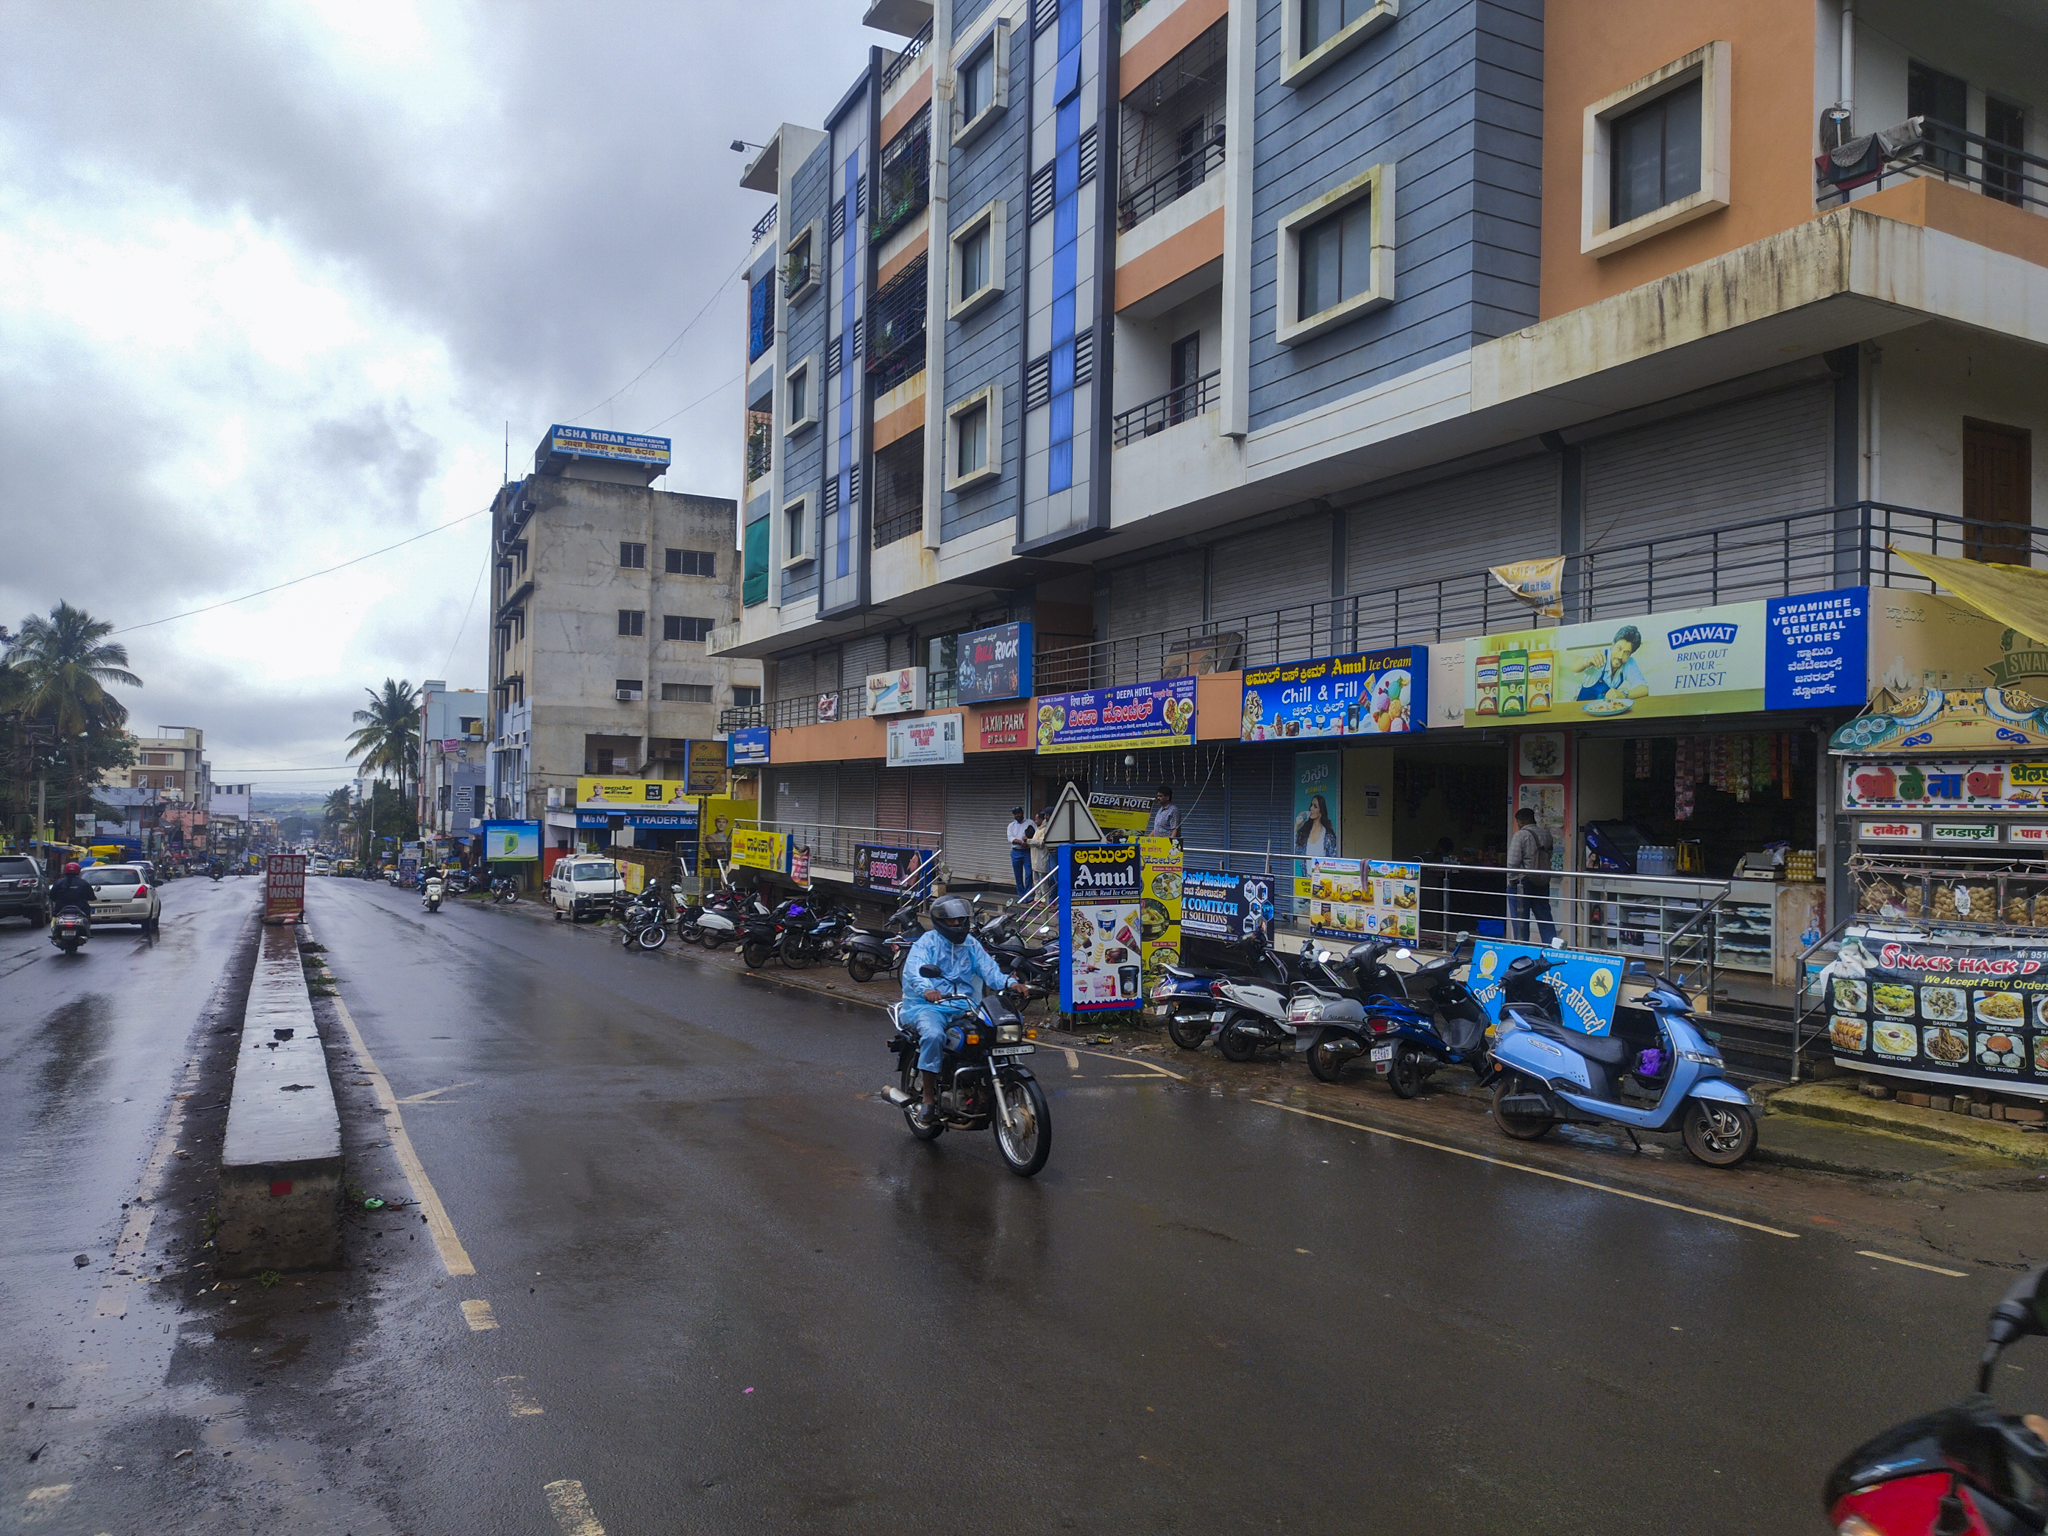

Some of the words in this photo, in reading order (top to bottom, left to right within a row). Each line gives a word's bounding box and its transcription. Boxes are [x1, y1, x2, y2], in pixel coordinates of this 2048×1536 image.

[557, 428, 588, 440] ASHA
[591, 431, 624, 444] KIRAN
[1778, 598, 1851, 615] SWAMINEE
[1772, 608, 1861, 626] VEGETABLES
[1670, 626, 1735, 646] DAAWAT
[1782, 621, 1846, 635] GENERAL
[1787, 631, 1841, 645] STORES
[974, 644, 994, 664] BULL
[995, 639, 1018, 661] ROCK
[1676, 651, 1706, 662] BRING
[1707, 648, 1728, 659] OUT
[1331, 656, 1367, 677] Amul
[1368, 660, 1381, 671] Ice
[1382, 657, 1412, 670] Cream
[1689, 661, 1715, 671] YOUR
[1245, 667, 1281, 686] ಅಮುಲ್
[1281, 667, 1299, 682] ಐಸ್
[1300, 663, 1326, 684] ಕ್ರೀಮ್
[1674, 671, 1727, 689] FINEST
[1795, 671, 1835, 683] ಜನರಲ್
[1116, 689, 1134, 700] DEEPA
[1134, 686, 1153, 697] HOTEL
[1281, 686, 1311, 704] Chill
[1317, 684, 1328, 701] &
[1334, 680, 1358, 700] Fill
[980, 713, 1026, 733] LAXMI-PARK
[1092, 795, 1120, 806] DEEPA
[1122, 798, 1151, 809] HOTEL
[596, 815, 631, 824] MAR
[635, 816, 678, 825] TRADER
[2020, 828, 2042, 839] पाव
[1074, 846, 1136, 863] ಅಮುಲ್
[270, 857, 304, 873] CAR
[870, 861, 897, 879] SCISSOR
[269, 874, 303, 886] FOAM
[1074, 864, 1135, 889] Amul
[269, 887, 302, 898] WASH
[1188, 898, 1239, 916] COMTECH
[1181, 910, 1188, 919] IT
[1189, 910, 1228, 925] SOLUTIONS
[1880, 943, 1954, 972] SNACK
[1958, 957, 2019, 975] HACK
[2021, 960, 2041, 974] D
[1924, 975, 1940, 984] We
[1941, 976, 1979, 988] Accept
[1980, 979, 2011, 990] Party
[2013, 980, 2048, 991] Orders
[1565, 985, 1607, 1035] सोसायटी
[1878, 1053, 1896, 1061] FINGER
[1935, 1060, 1959, 1068] NOODLES
